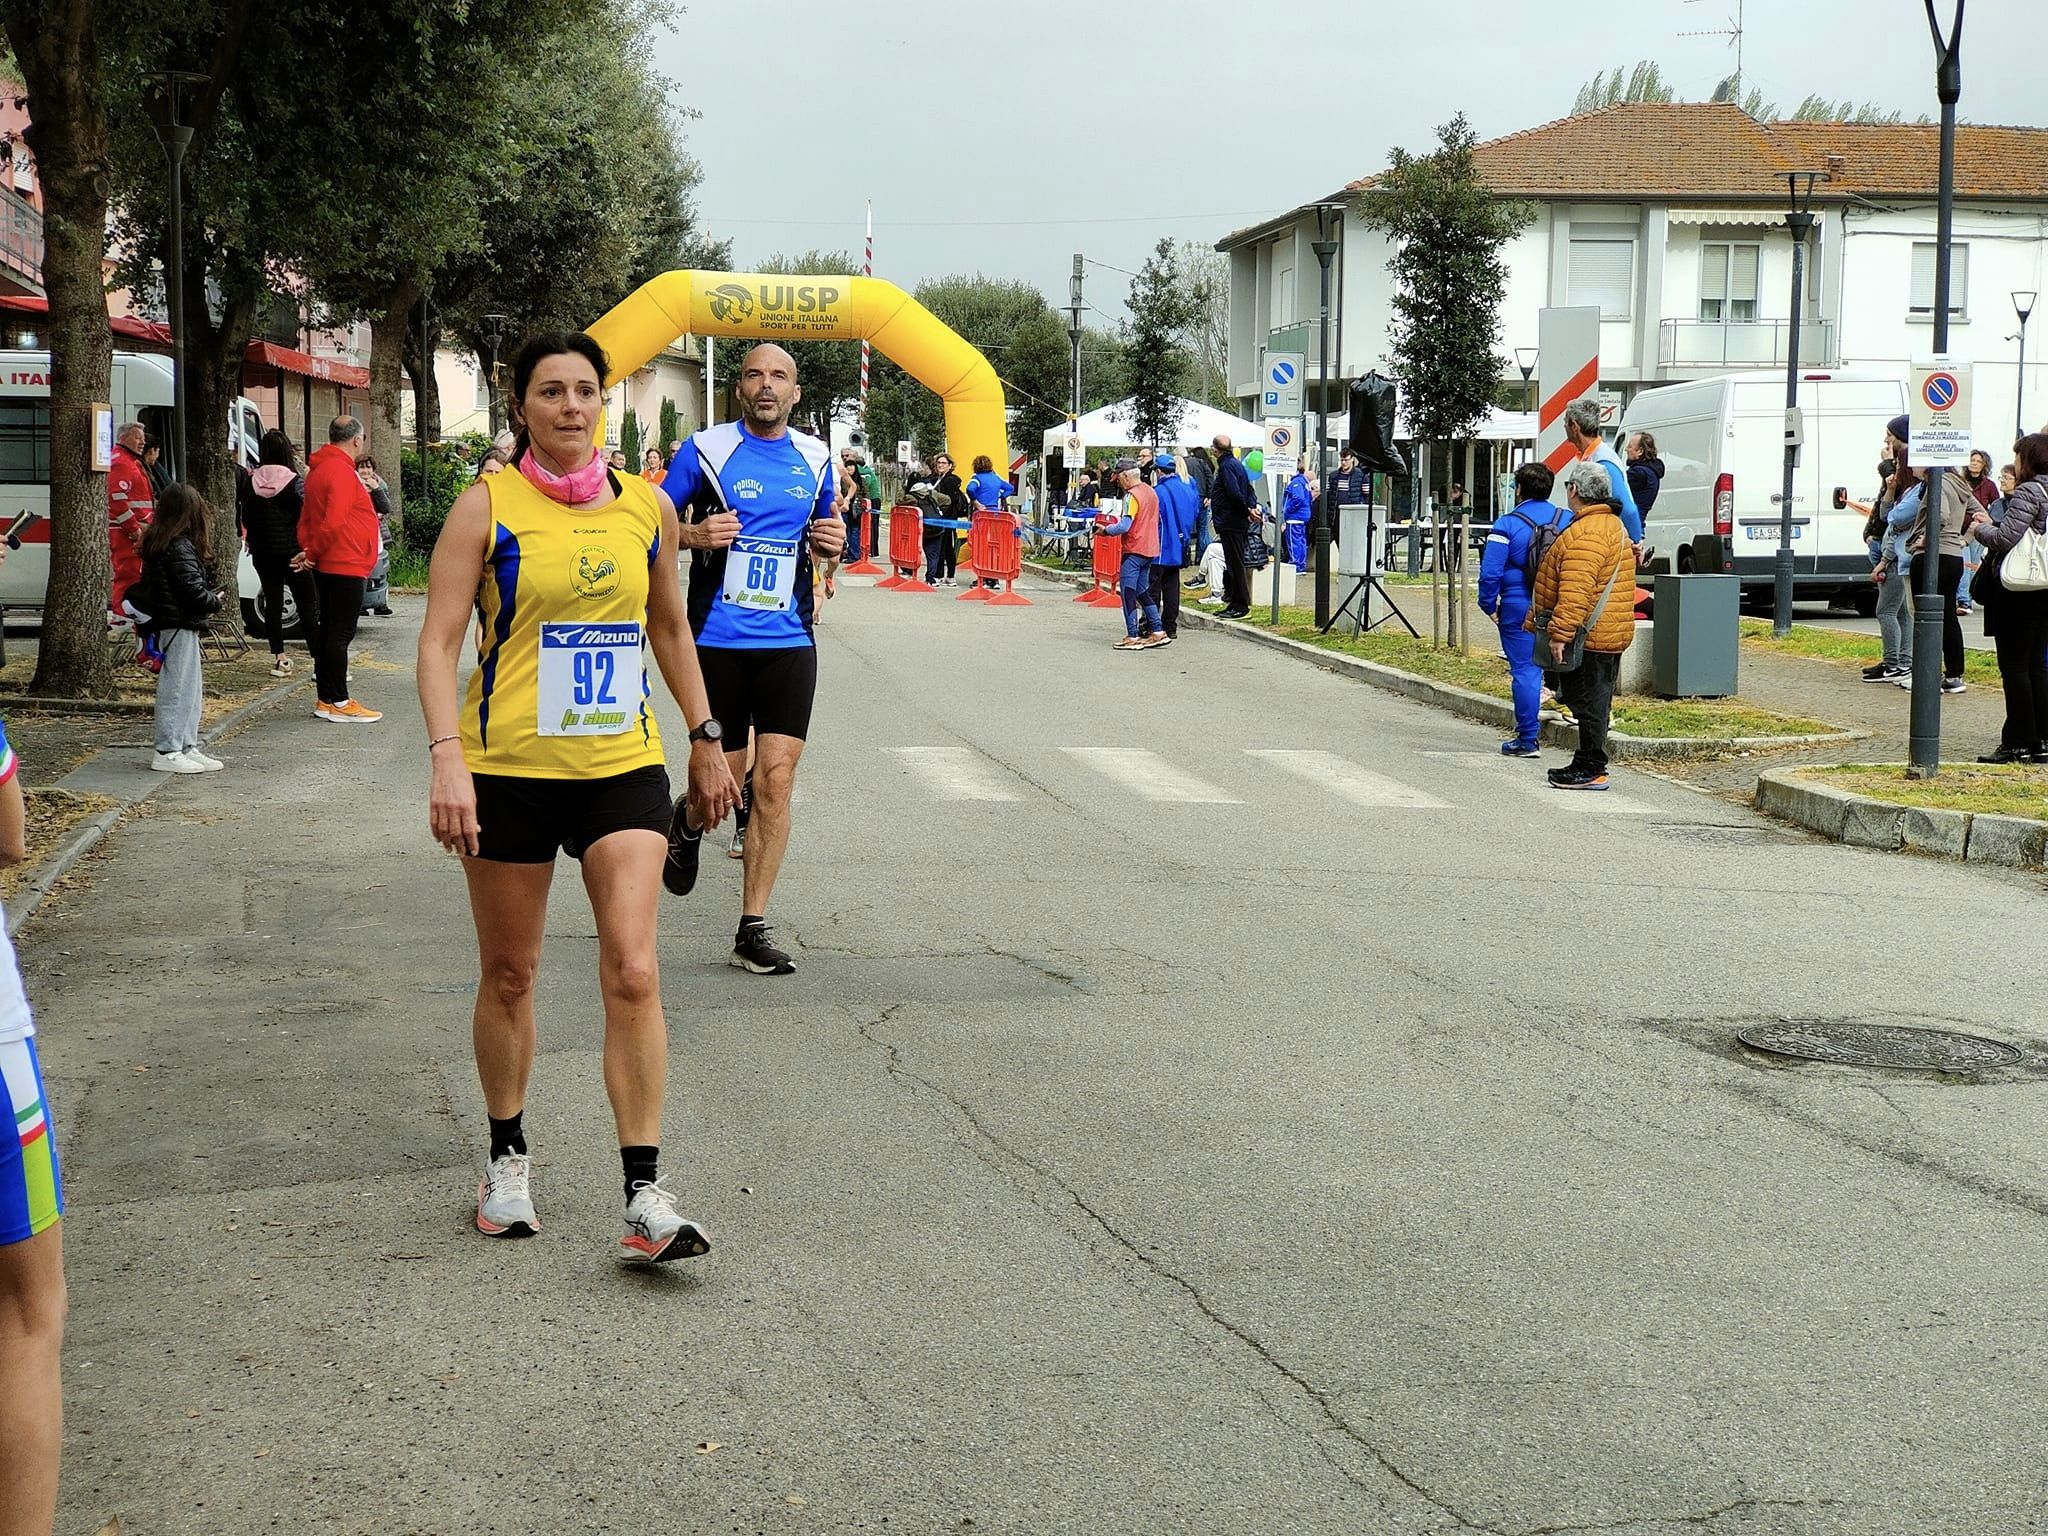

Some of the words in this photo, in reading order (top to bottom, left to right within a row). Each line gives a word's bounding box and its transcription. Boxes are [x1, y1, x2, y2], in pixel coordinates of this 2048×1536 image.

[760, 285, 839, 312] UISP
[760, 313, 795, 322] UNIONE
[799, 315, 839, 323] ITALIANA
[760, 322, 788, 330] SPORT
[811, 323, 834, 331] TUTTI
[1267, 393, 1276, 403] P
[733, 479, 764, 494] PODISTICA
[747, 556, 778, 591] 68
[573, 651, 617, 705] 92
